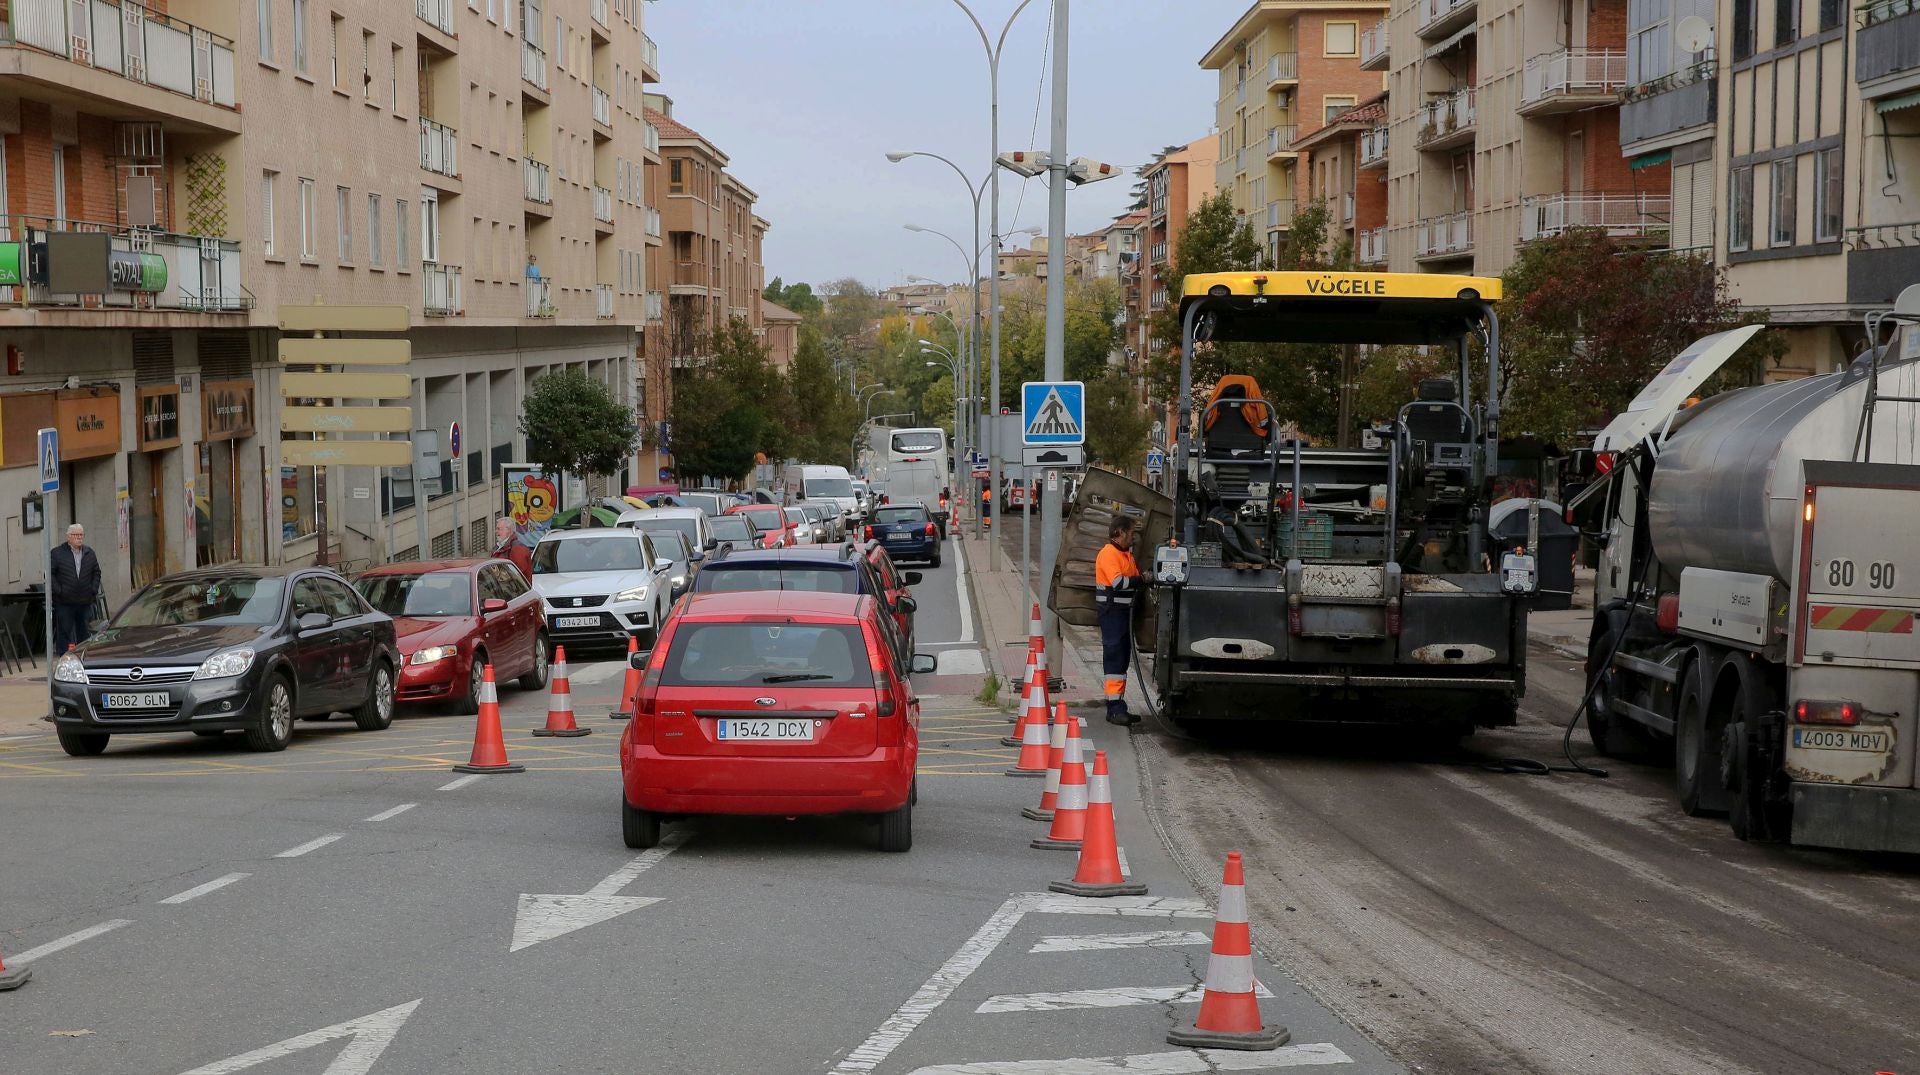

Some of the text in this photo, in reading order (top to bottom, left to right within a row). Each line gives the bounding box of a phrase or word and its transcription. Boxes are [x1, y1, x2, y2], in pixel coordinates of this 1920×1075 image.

[112, 260, 142, 284] ENTAL
[1306, 275, 1385, 295] VÖGELE
[1829, 560, 1895, 590] 80 90
[561, 617, 599, 627] 9342 LDK
[109, 694, 166, 707] 6062 GLN
[732, 722, 770, 738] 1542
[777, 722, 808, 737] DCX
[1803, 731, 1881, 749] 4003 MDV
